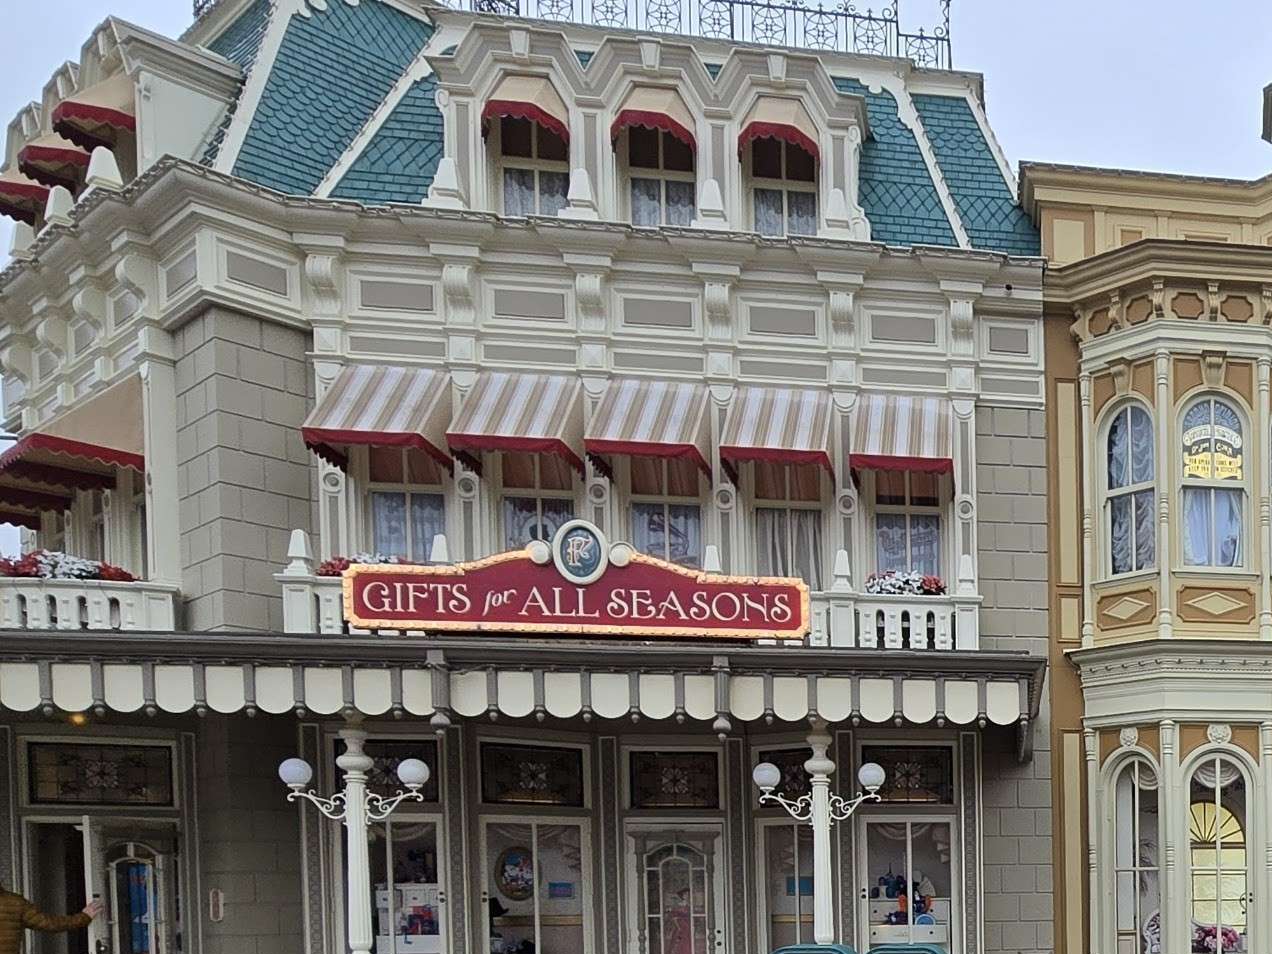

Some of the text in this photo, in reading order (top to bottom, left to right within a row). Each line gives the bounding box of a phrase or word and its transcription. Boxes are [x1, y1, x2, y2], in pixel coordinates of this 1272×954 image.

[362, 581, 792, 623] GIFTS for ALL SEASONS
